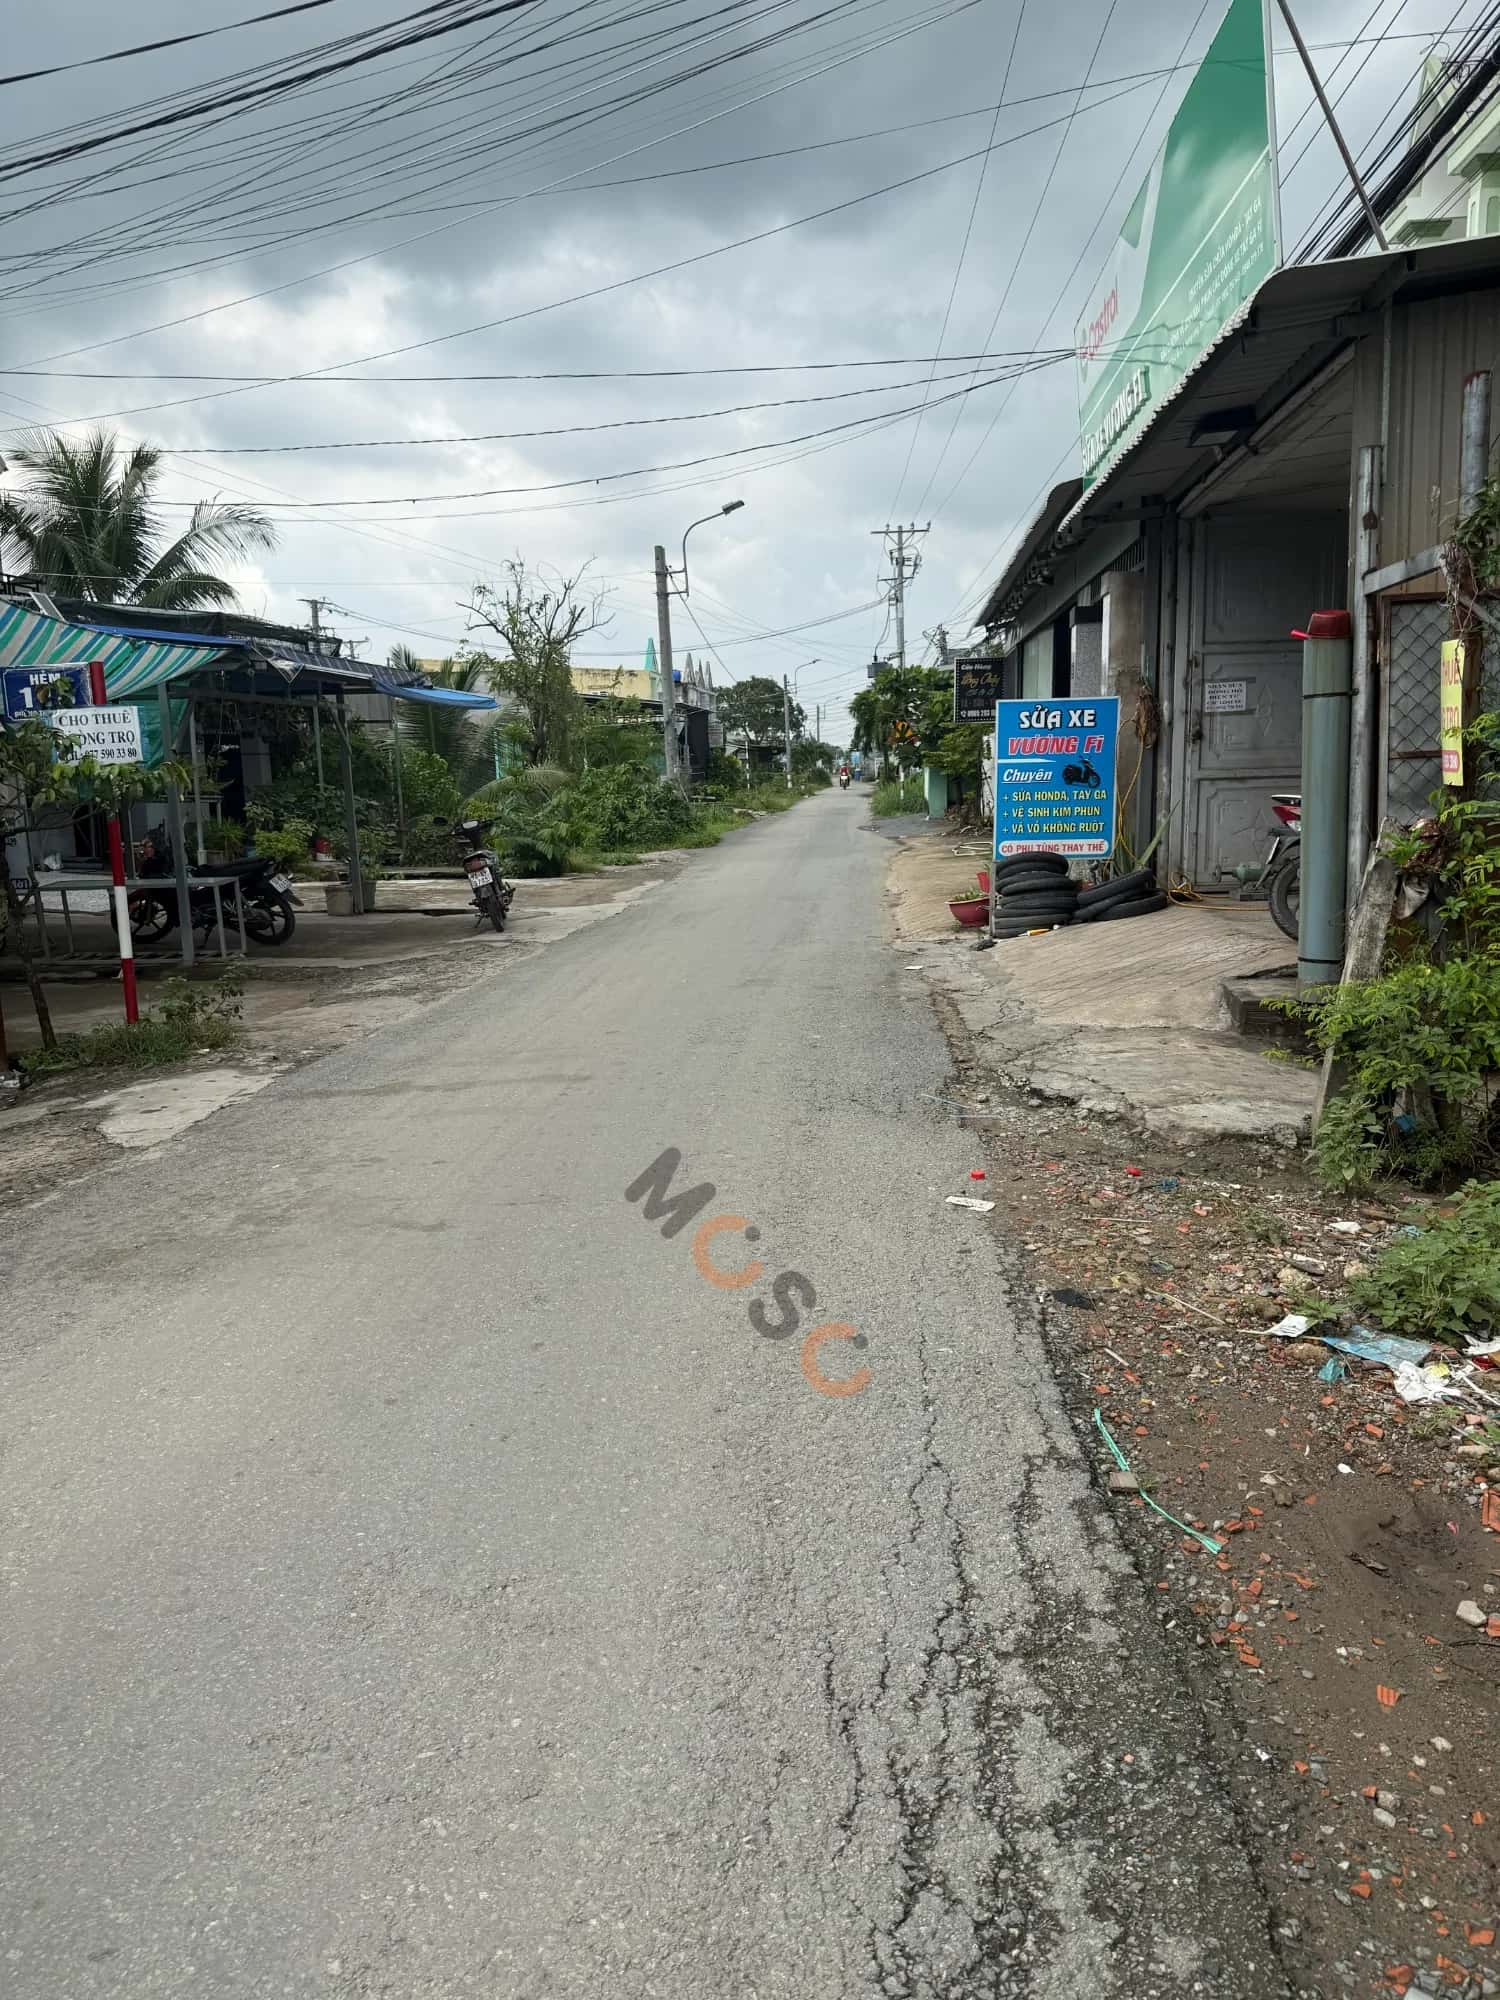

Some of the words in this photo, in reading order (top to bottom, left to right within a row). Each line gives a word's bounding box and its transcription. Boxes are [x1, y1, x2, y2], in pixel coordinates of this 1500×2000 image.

[29, 670, 61, 686] HẺM
[58, 714, 89, 727] CHO
[92, 710, 132, 725] THUÊ
[1019, 705, 1061, 729] SỬA
[1068, 709, 1096, 727] XE
[108, 730, 135, 746] TRỌ
[1008, 734, 1080, 755] VƯƠNG
[101, 748, 115, 759] 590
[117, 747, 126, 759] 33
[1003, 769, 1053, 783] Chuyên
[1073, 790, 1091, 800] TAY
[1094, 790, 1107, 800] GA
[1027, 807, 1049, 816] SINH
[1053, 807, 1071, 816] KIM
[1074, 806, 1100, 816] PHUN
[1043, 821, 1076, 833] KHÔNG
[1062, 843, 1085, 852] THAY
[1087, 840, 1105, 851] THẾ
